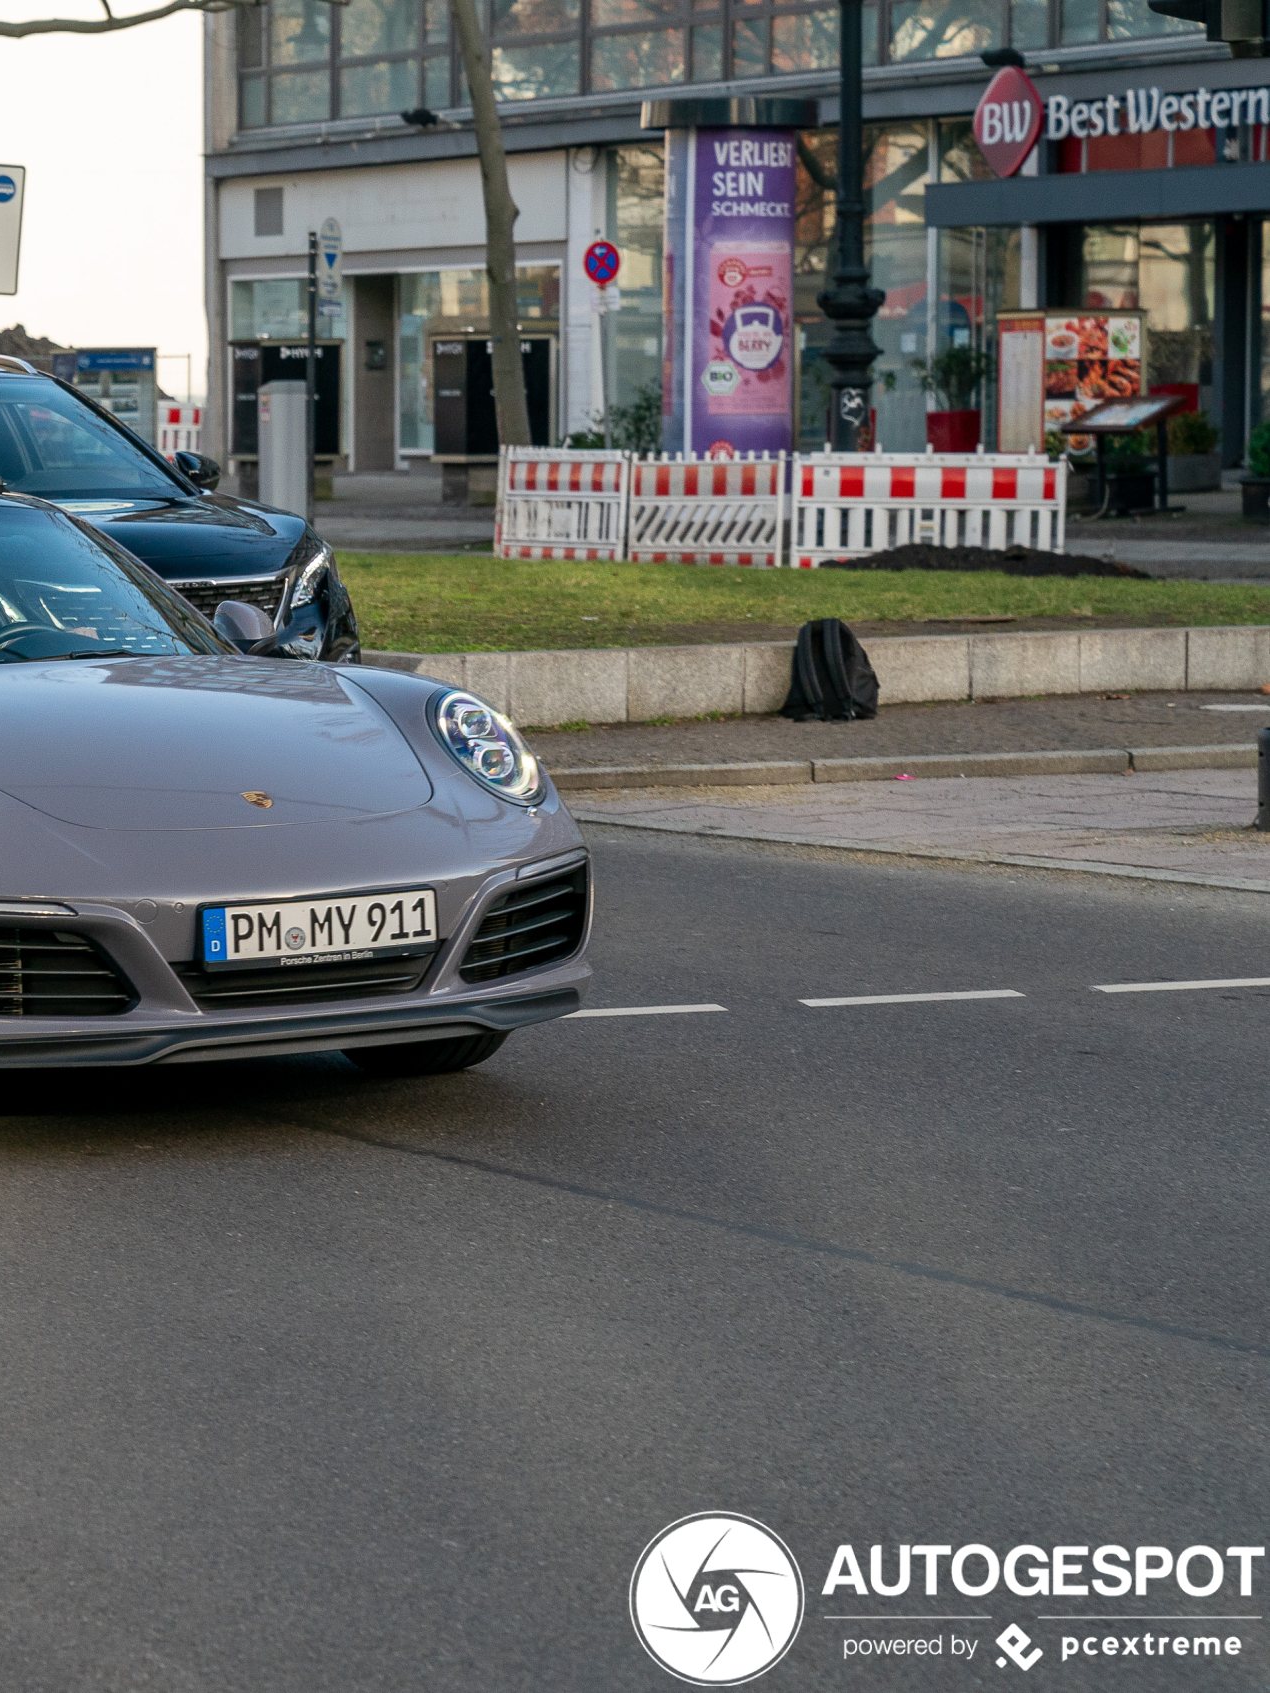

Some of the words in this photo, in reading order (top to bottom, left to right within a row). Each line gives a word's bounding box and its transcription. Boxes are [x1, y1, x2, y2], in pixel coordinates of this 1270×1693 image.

[982, 100, 1032, 145] BW
[1046, 94, 1121, 141] Best
[1126, 86, 1270, 133] Western
[713, 139, 793, 168] VERLIEBT
[712, 171, 764, 198] SEIN
[738, 339, 771, 352] BERRY
[710, 371, 733, 382] BIO
[231, 911, 281, 953] PM
[310, 904, 357, 947] MY
[367, 897, 432, 942] 911
[211, 940, 220, 952] D
[280, 956, 312, 966] Porsche
[313, 954, 342, 963] Zentren
[343, 952, 351, 961] in
[352, 950, 373, 960] Berlin
